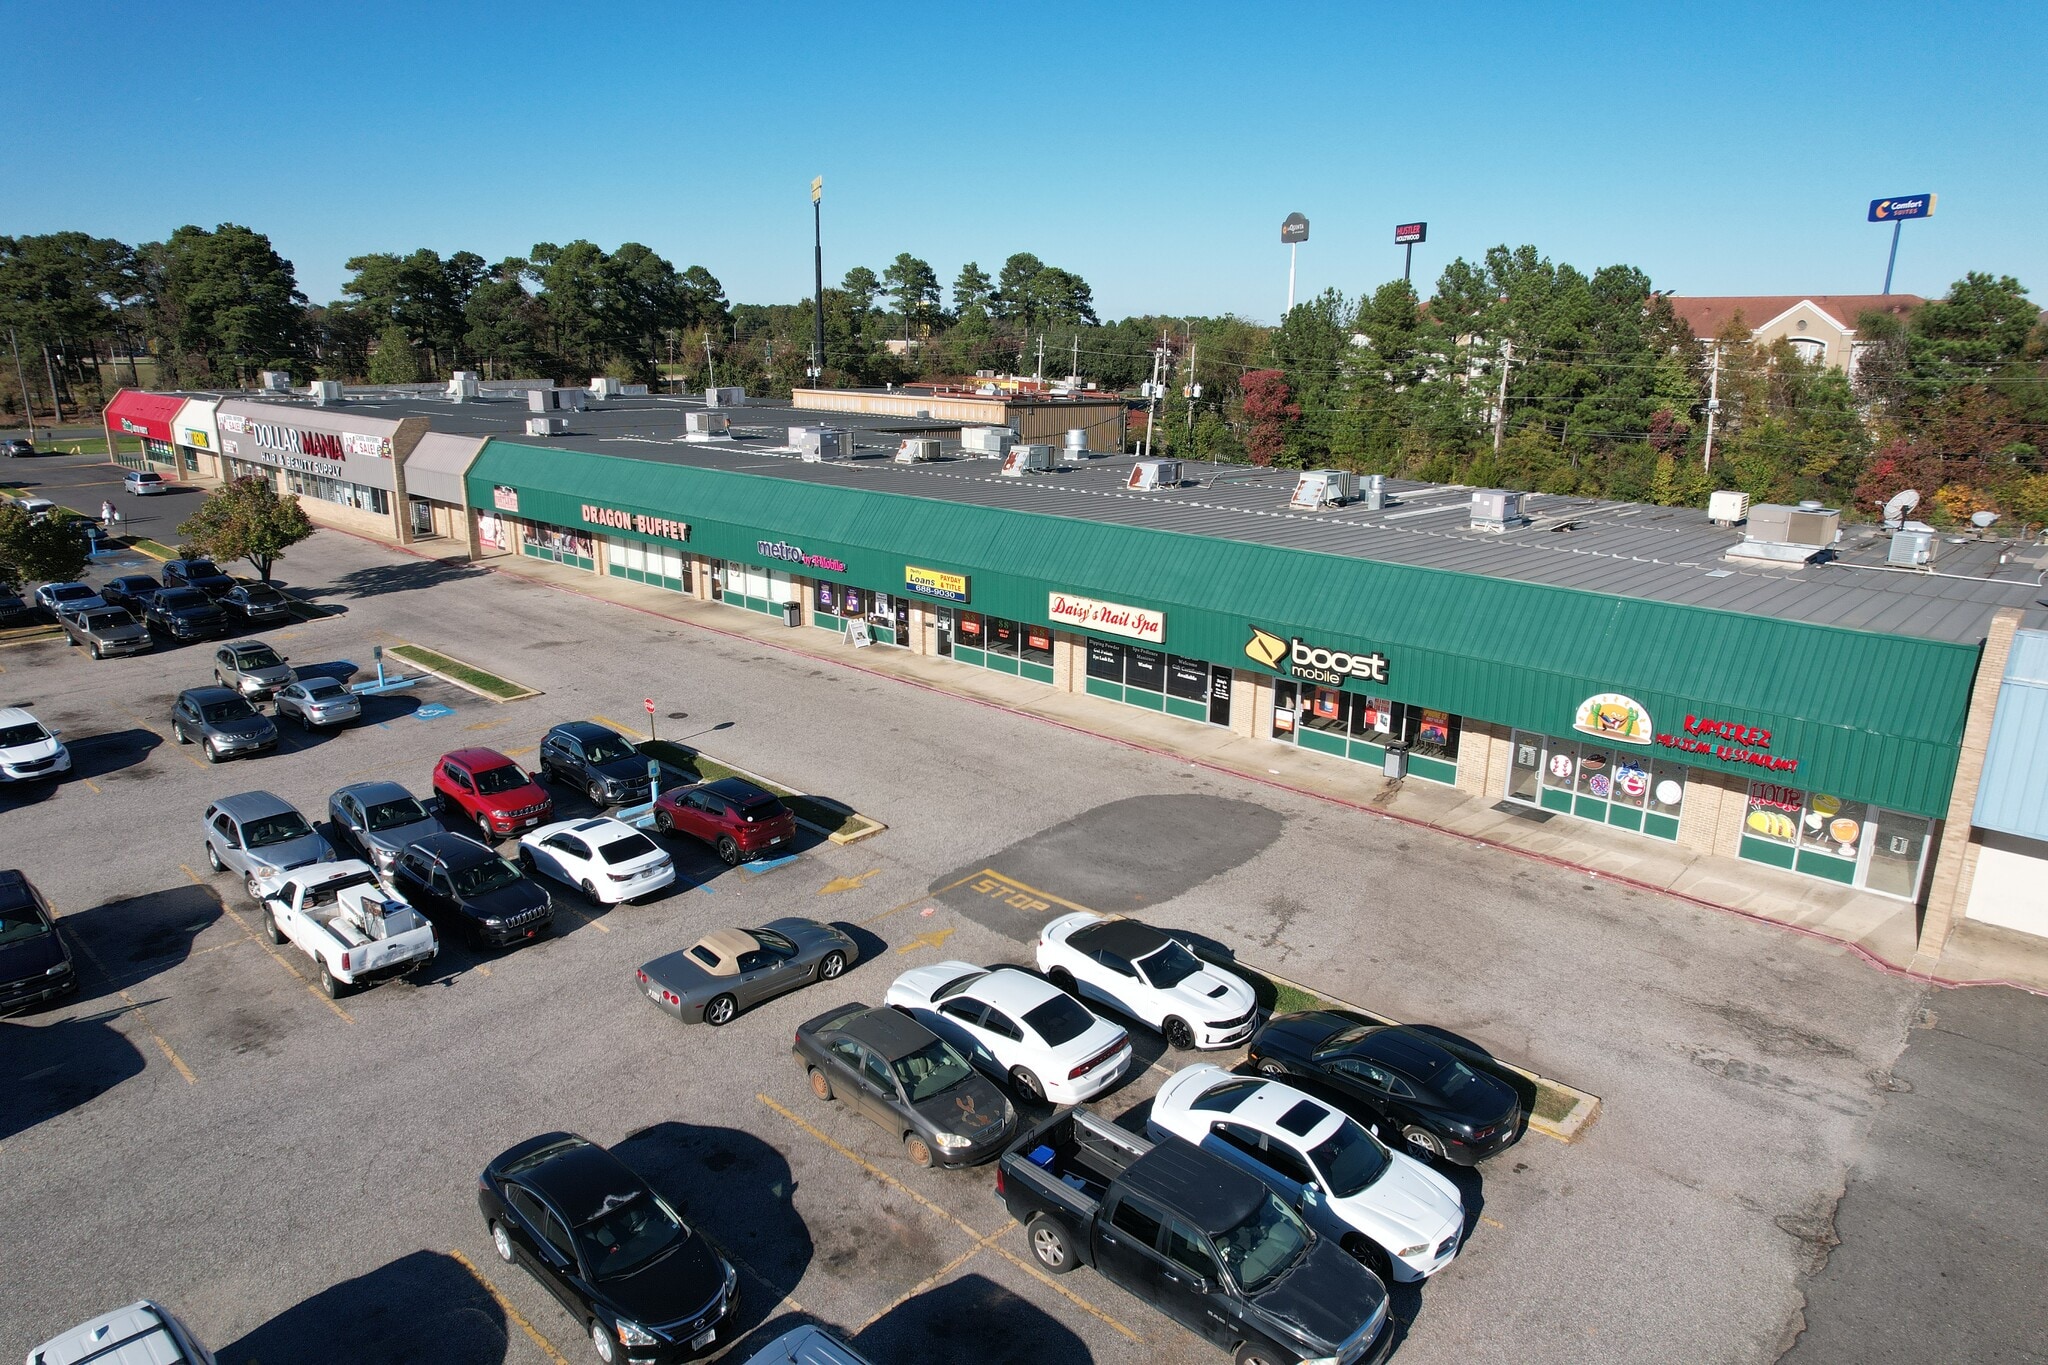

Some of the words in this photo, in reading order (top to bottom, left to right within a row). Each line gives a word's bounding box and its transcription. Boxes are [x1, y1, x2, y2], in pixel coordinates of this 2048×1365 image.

[1891, 200, 1923, 210] Comfort
[1397, 224, 1420, 235] HUSTLER
[253, 422, 300, 454] DOLLAR
[301, 431, 346, 462] MANIA
[261, 452, 277, 464] HAIR
[286, 456, 314, 471] BEAUTY
[314, 462, 342, 477] SUPPLY
[581, 504, 632, 530] DRAGON
[637, 514, 687, 541] BUFFET
[757, 540, 802, 562] metro
[910, 574, 935, 586] Loans
[915, 584, 956, 599] 688-9030
[940, 574, 961, 584] PAYDAY
[946, 582, 961, 592] TITLE
[1051, 596, 1098, 623] Daisy's
[1100, 606, 1130, 627] Nail
[1132, 613, 1159, 635] Spa
[1292, 638, 1385, 681] boost
[1291, 665, 1340, 684] mobile
[1683, 713, 1772, 749] RAMIREZ
[1655, 732, 1711, 754] MEXICAN
[1716, 744, 1799, 773] RESTAURANT
[1749, 782, 1803, 812] HOUR
[970, 879, 1051, 912] STOP
